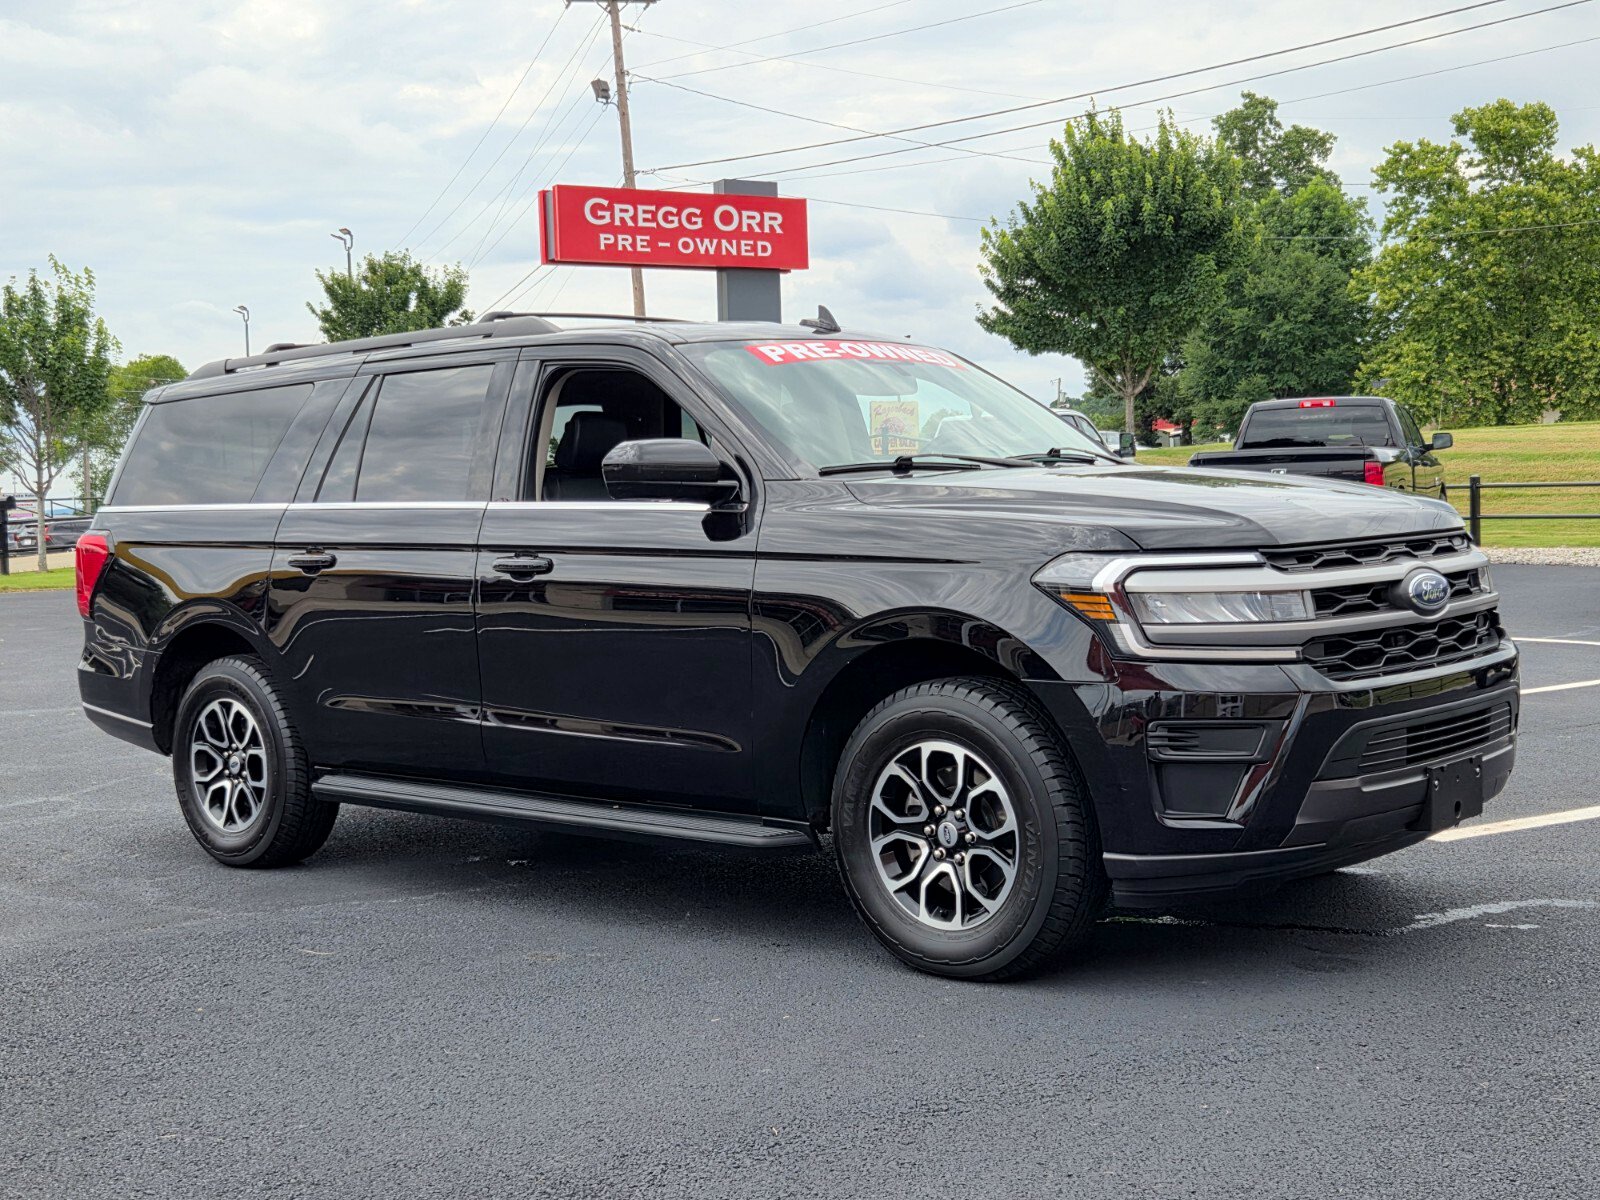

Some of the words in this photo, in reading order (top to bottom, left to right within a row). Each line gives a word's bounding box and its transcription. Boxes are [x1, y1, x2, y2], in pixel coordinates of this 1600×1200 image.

[584, 197, 702, 230] GREGG
[713, 205, 784, 234] ORR
[757, 342, 957, 368] PRE-OWNED
[1421, 580, 1445, 600] Ford
